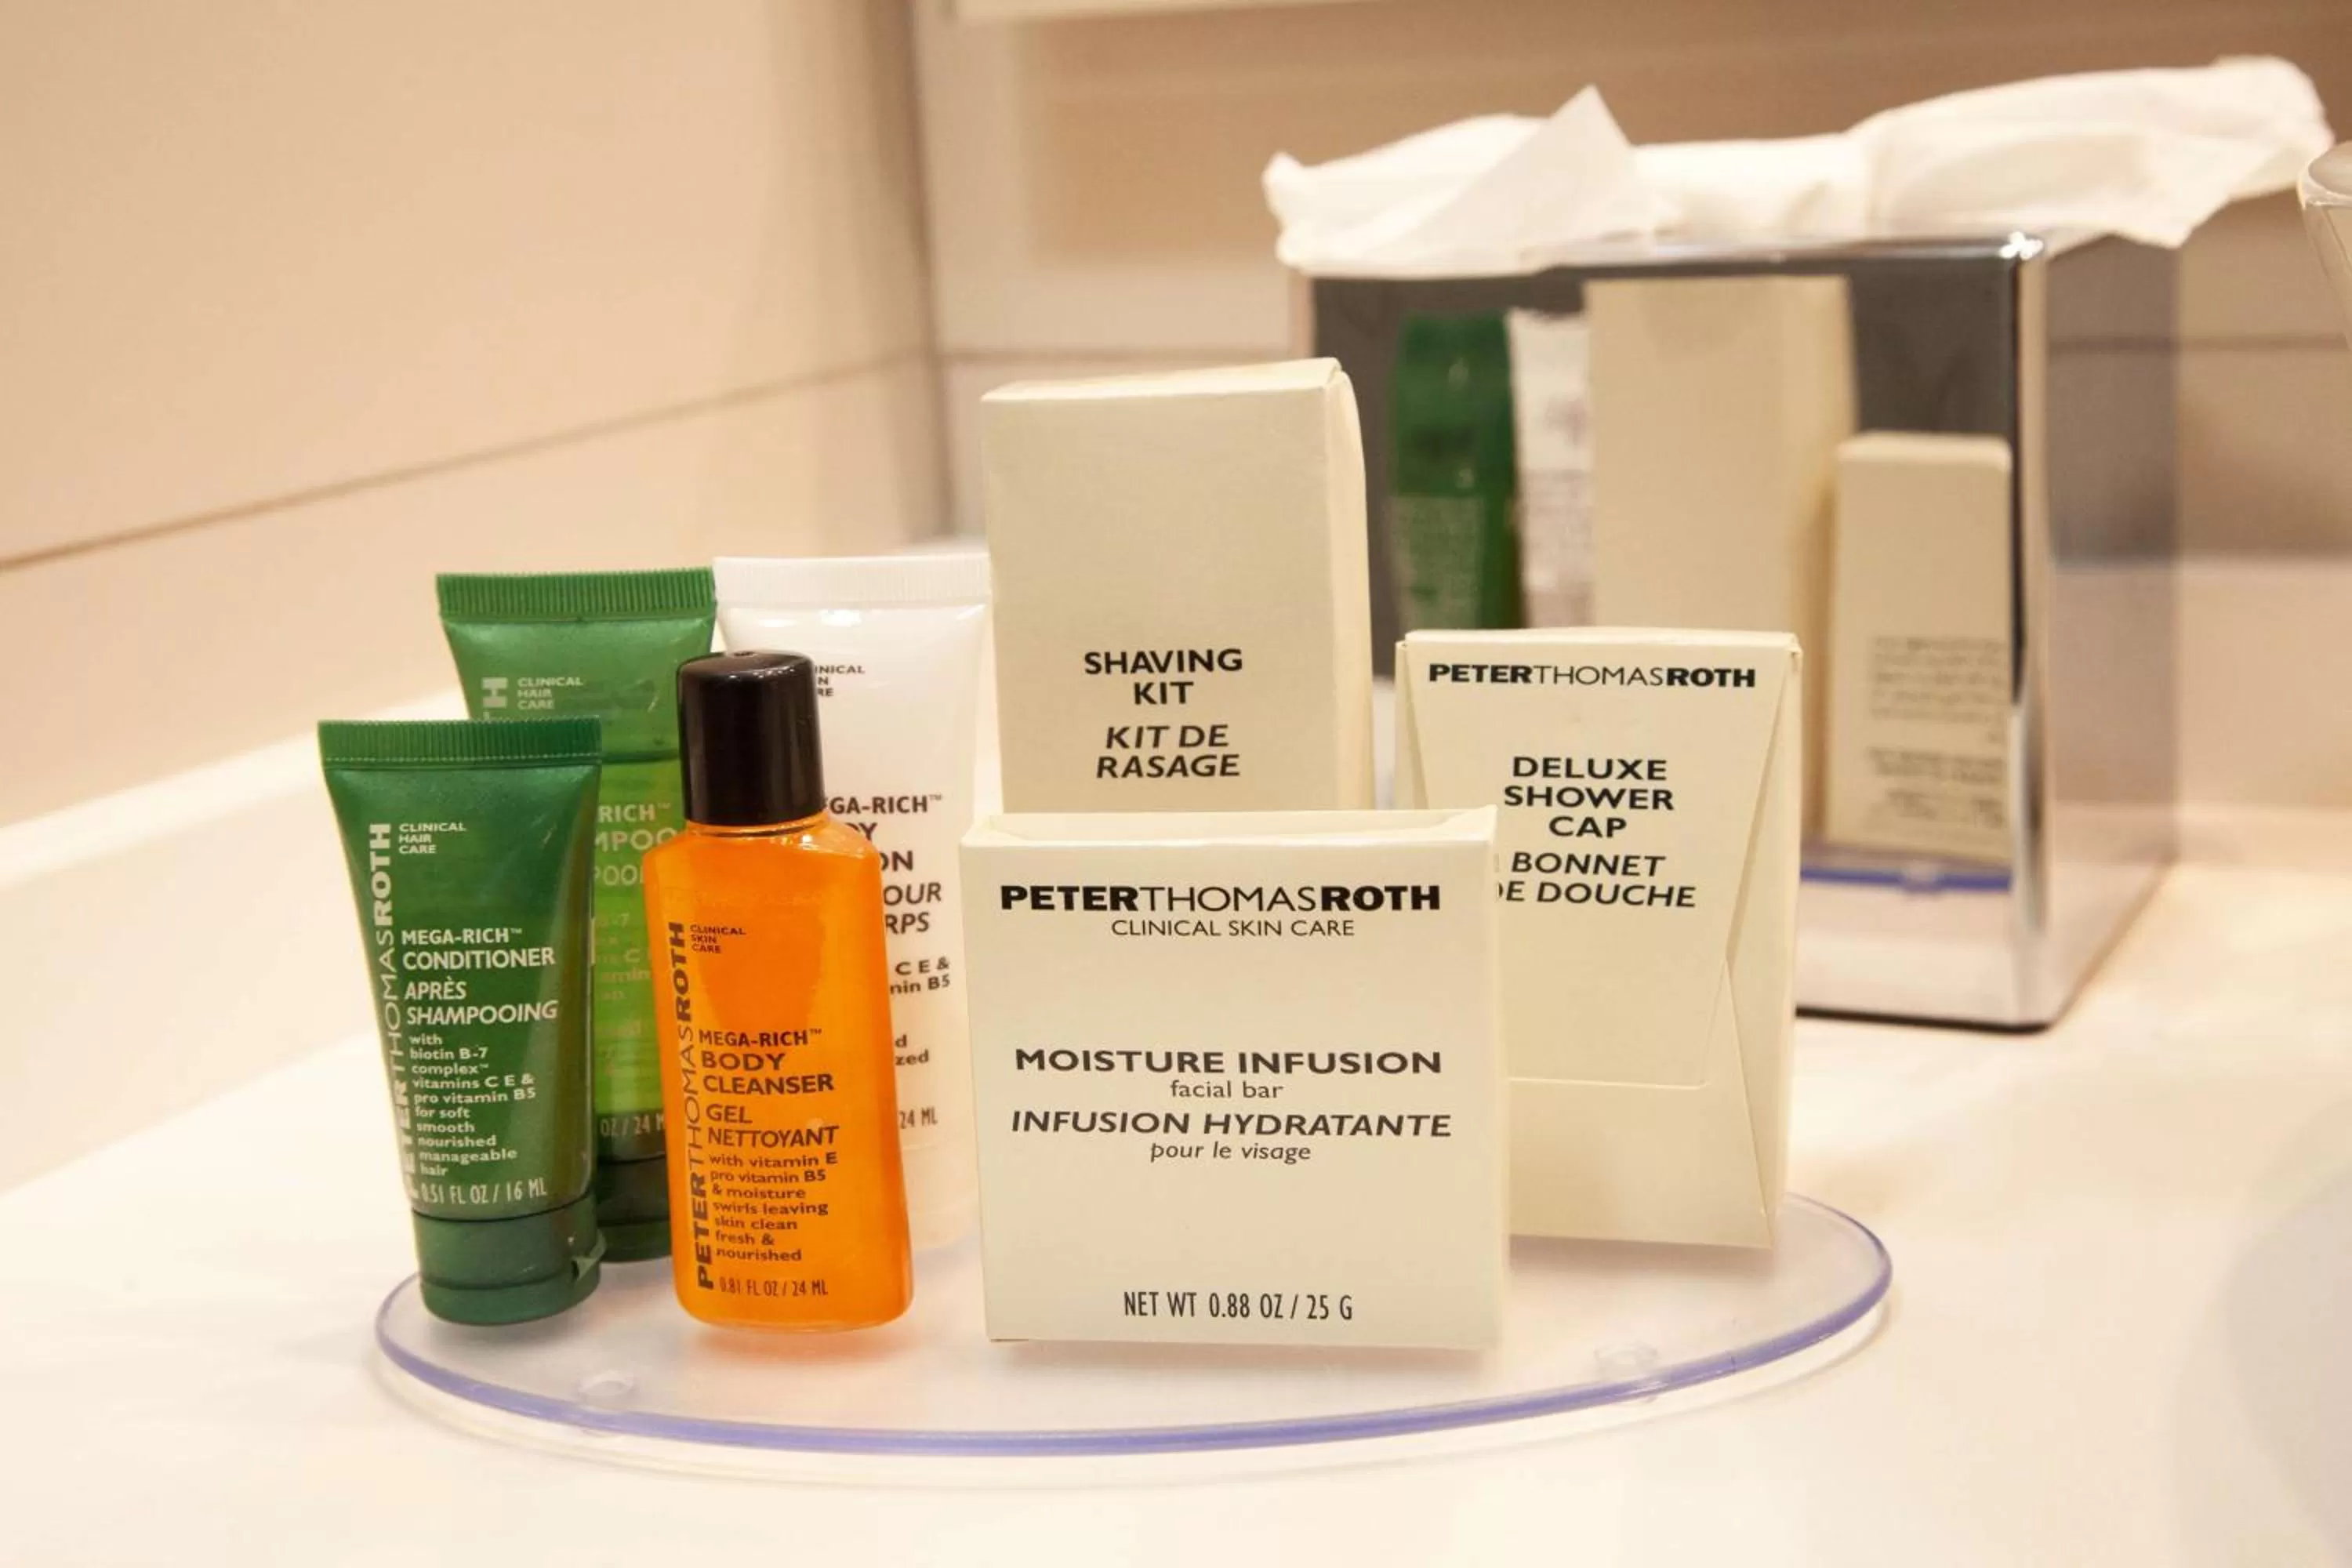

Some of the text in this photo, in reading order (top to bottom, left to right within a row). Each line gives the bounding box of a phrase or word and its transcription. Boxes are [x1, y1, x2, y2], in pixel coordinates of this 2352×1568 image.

[1084, 648, 1243, 675] SHAVING
[517, 677, 583, 688] CLINICAL
[1428, 663, 1756, 688] PETERTHOMASROTH
[517, 688, 552, 699] HAIR
[1134, 681, 1194, 705] KIT
[517, 699, 555, 710] CARE
[1105, 724, 1229, 749] KIT DE
[1096, 753, 1240, 779] RASAGE
[1512, 755, 1668, 781] DELUXE
[1504, 785, 1675, 811] SHOWER
[398, 822, 466, 833] CLINICAL
[1548, 815, 1628, 838] CAP
[398, 833, 431, 843] HAIR
[398, 844, 436, 854] CARE
[1511, 851, 1667, 877] BONNET
[884, 881, 942, 906] OUR
[1000, 884, 1441, 913] PETERTHOMASROTH
[1537, 882, 1697, 908] DOUCHE
[690, 924, 746, 935] CLINICAL
[884, 911, 930, 935] RPS
[1110, 918, 1356, 937] CLINICAL SKIN CARE
[691, 934, 717, 944] SKIN
[691, 943, 721, 954] CARE
[402, 946, 556, 970] CONDITIONER
[895, 956, 950, 975] C E &
[405, 976, 467, 1000] APRÈS
[927, 974, 951, 991] B5
[407, 1000, 559, 1025] SHAMPOOING
[409, 1033, 442, 1045] with
[410, 1047, 488, 1060] biotin B-7
[701, 1051, 786, 1072] BODY
[1015, 1048, 1442, 1074] MOISTURE INFUSION
[412, 1073, 535, 1090] vitamins C E &
[702, 1073, 835, 1095] CLEANSER
[1170, 1080, 1284, 1099] facial bar
[415, 1087, 536, 1105] pro vitamin B5
[668, 921, 714, 1290] PETERTHOMASROTH
[415, 1106, 470, 1119] for soft
[706, 1103, 753, 1125] GEL
[921, 1105, 938, 1126] ML
[416, 1121, 475, 1134] smooth
[633, 1116, 651, 1134] 24
[1011, 1111, 1452, 1138] INFUSION HYDRATANTE
[418, 1135, 497, 1149] nourished
[707, 1125, 840, 1148] NETTOYANT
[419, 1148, 517, 1165] manageable
[709, 1152, 838, 1169] with vitamin E
[1149, 1141, 1312, 1164] pour le visage
[420, 1164, 448, 1177] hair
[710, 1168, 826, 1184] pro vitamin B5
[450, 1185, 466, 1205] FL
[470, 1184, 488, 1205] OZ
[492, 1184, 499, 1202] /
[506, 1181, 524, 1200] 16
[528, 1177, 547, 1199] ML
[712, 1185, 806, 1200] & moisture
[713, 1200, 829, 1216] swirls leaving
[715, 1216, 798, 1231] skin clean
[716, 1230, 775, 1246] fresh &
[716, 1246, 803, 1262] nourished
[747, 1279, 759, 1296] FL
[764, 1280, 779, 1297] OZ
[782, 1280, 789, 1296] /
[792, 1279, 808, 1296] 24
[812, 1279, 829, 1295] ML
[1123, 1290, 1353, 1320] NET WT 0.88 OZ / 25 G
